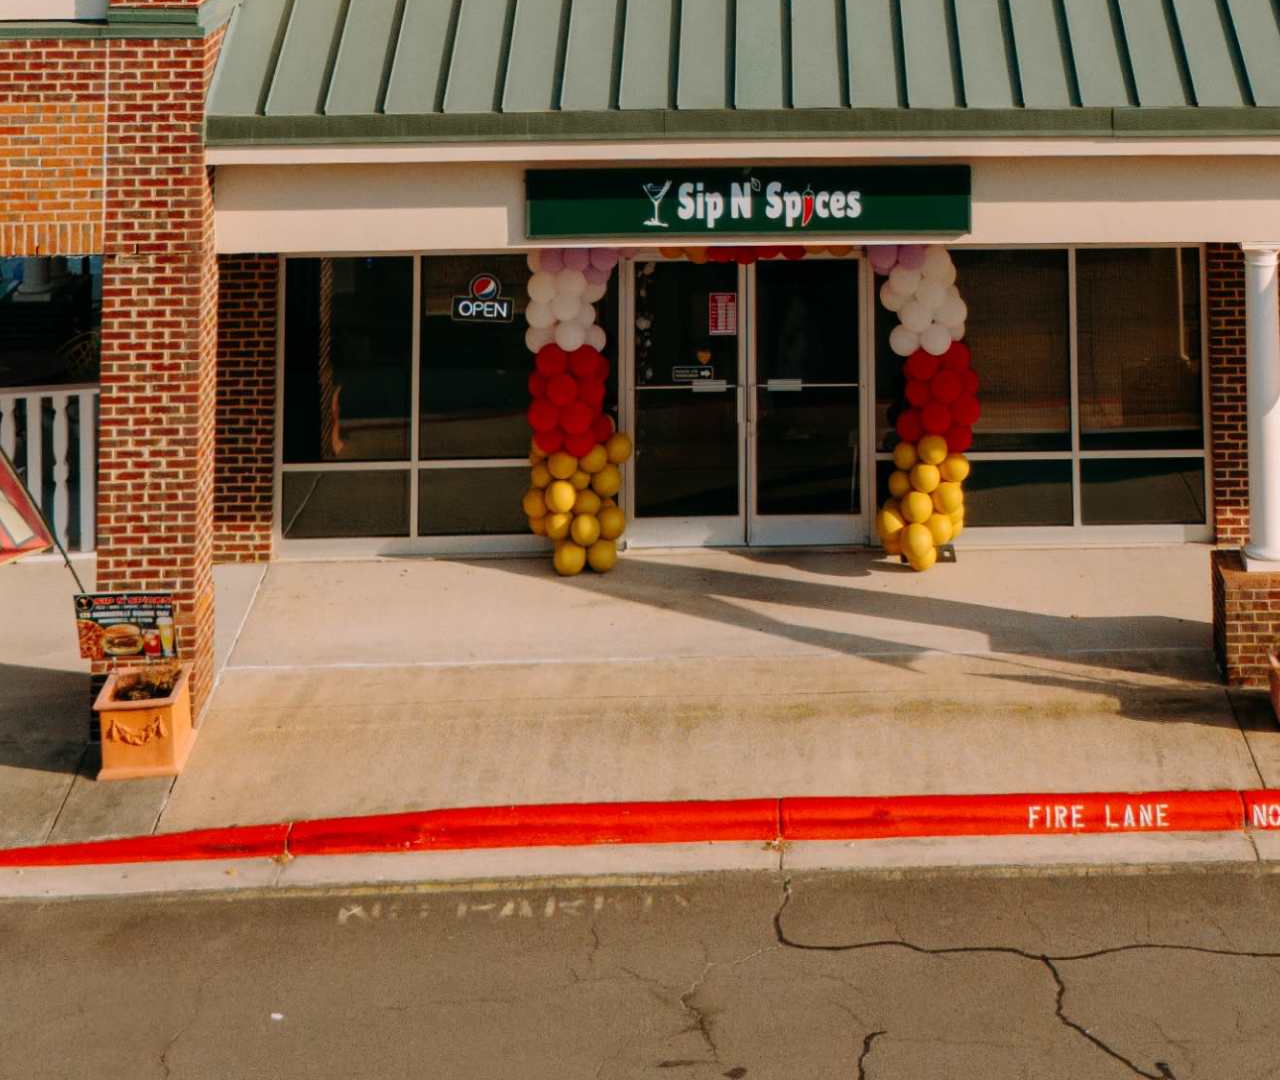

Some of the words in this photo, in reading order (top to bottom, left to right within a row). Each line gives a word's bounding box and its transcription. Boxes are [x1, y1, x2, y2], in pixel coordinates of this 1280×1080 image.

[677, 182, 724, 228] Sip
[765, 181, 862, 228] Spices
[458, 300, 508, 318] OPEN
[1027, 805, 1085, 829] FIRE
[1105, 804, 1169, 828] LANE
